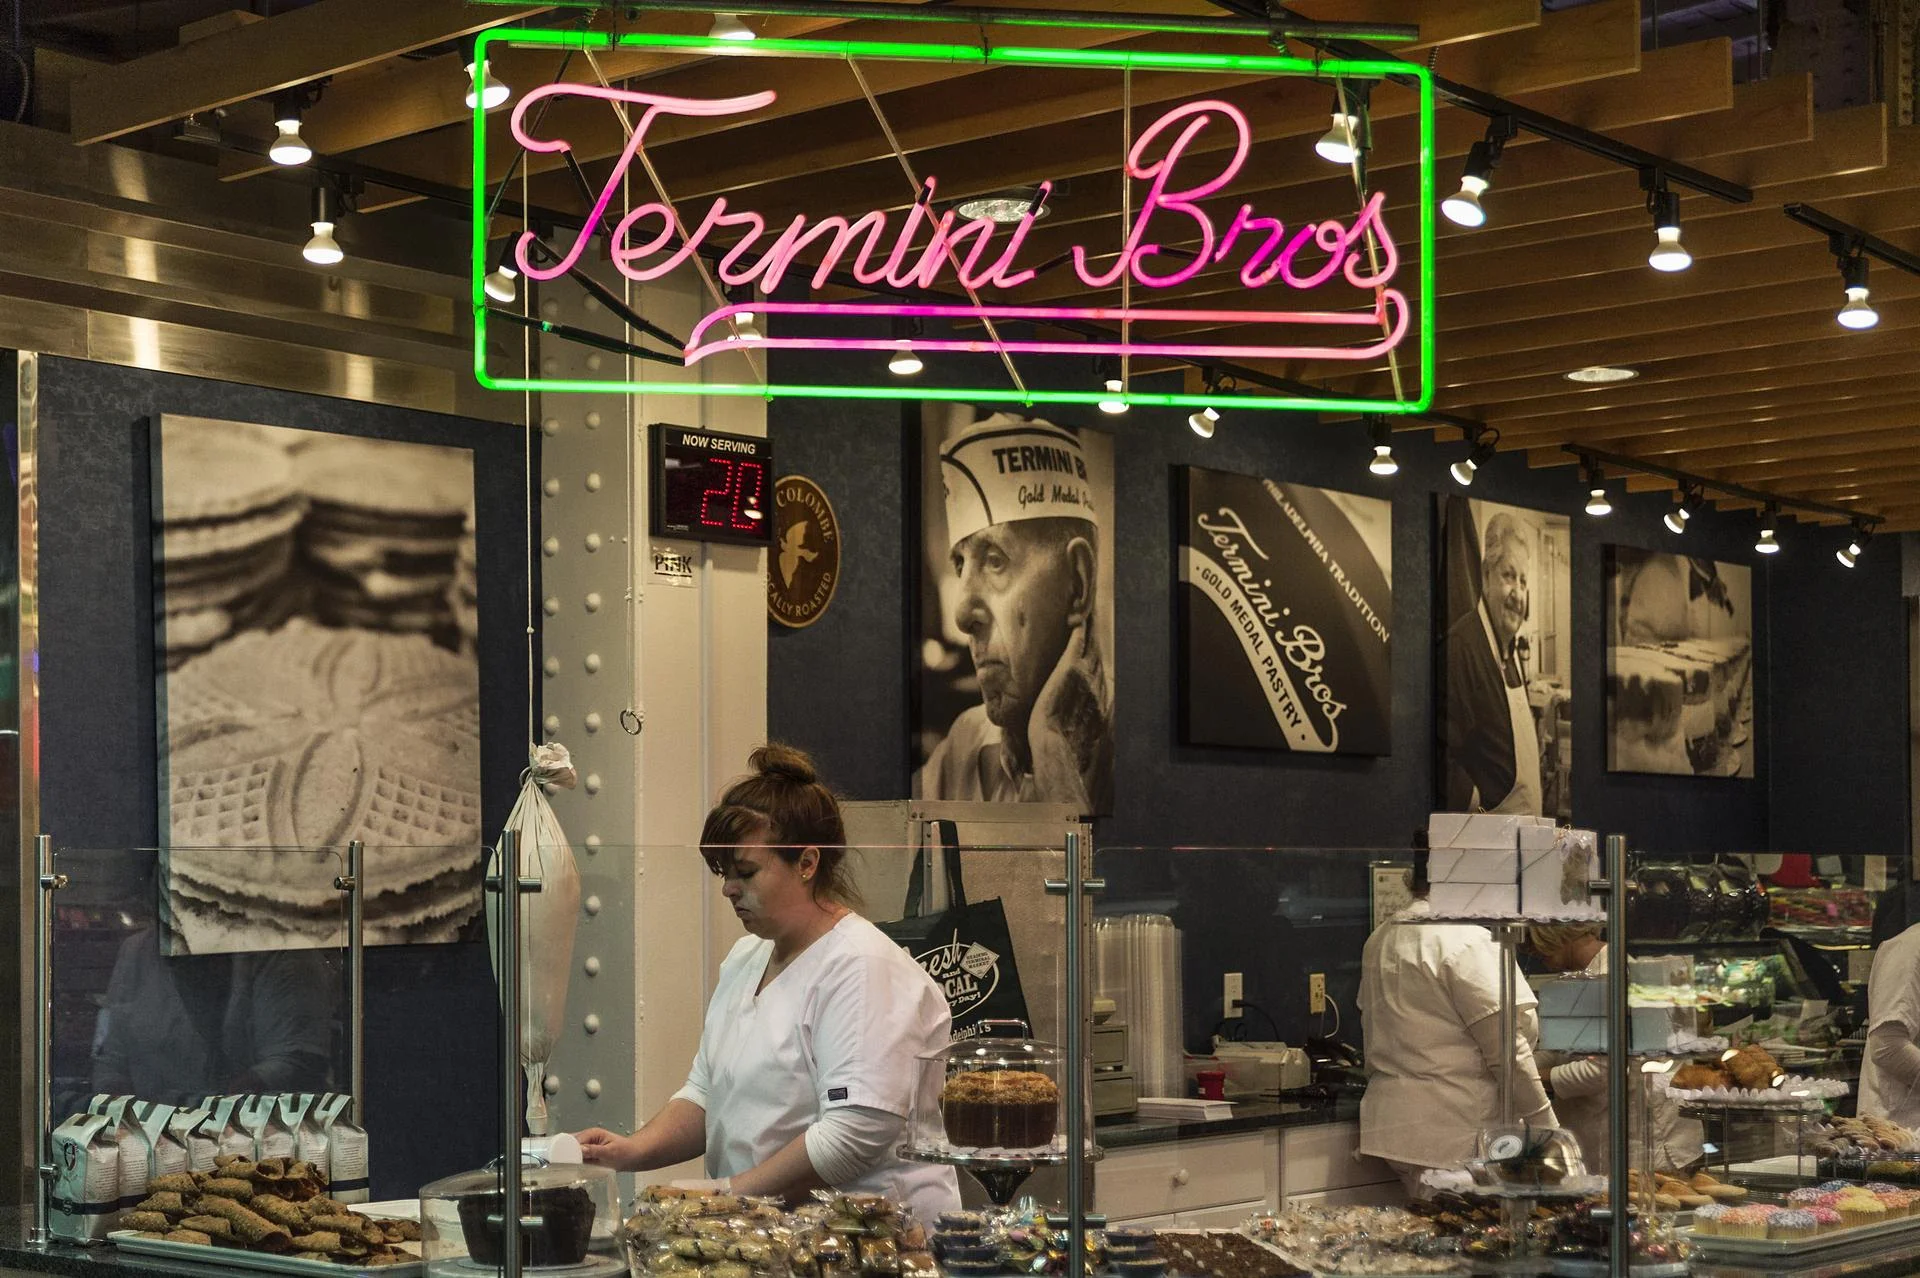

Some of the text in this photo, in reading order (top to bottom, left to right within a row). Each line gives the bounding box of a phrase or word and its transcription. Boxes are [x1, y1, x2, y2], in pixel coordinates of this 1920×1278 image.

[511, 83, 1397, 295] Termini Bros
[682, 434, 756, 455] NOW SERVING
[992, 447, 1074, 475] TERMINI
[700, 457, 763, 531] 20
[776, 487, 834, 543] COLOMBE
[1018, 483, 1045, 511] Gold
[767, 571, 832, 617] OCALLY ROASTED
[1197, 506, 1347, 722] Termini Bros
[1328, 560, 1390, 645] TRADITION
[1201, 567, 1303, 729] GOLD MEDAL PASTRY
